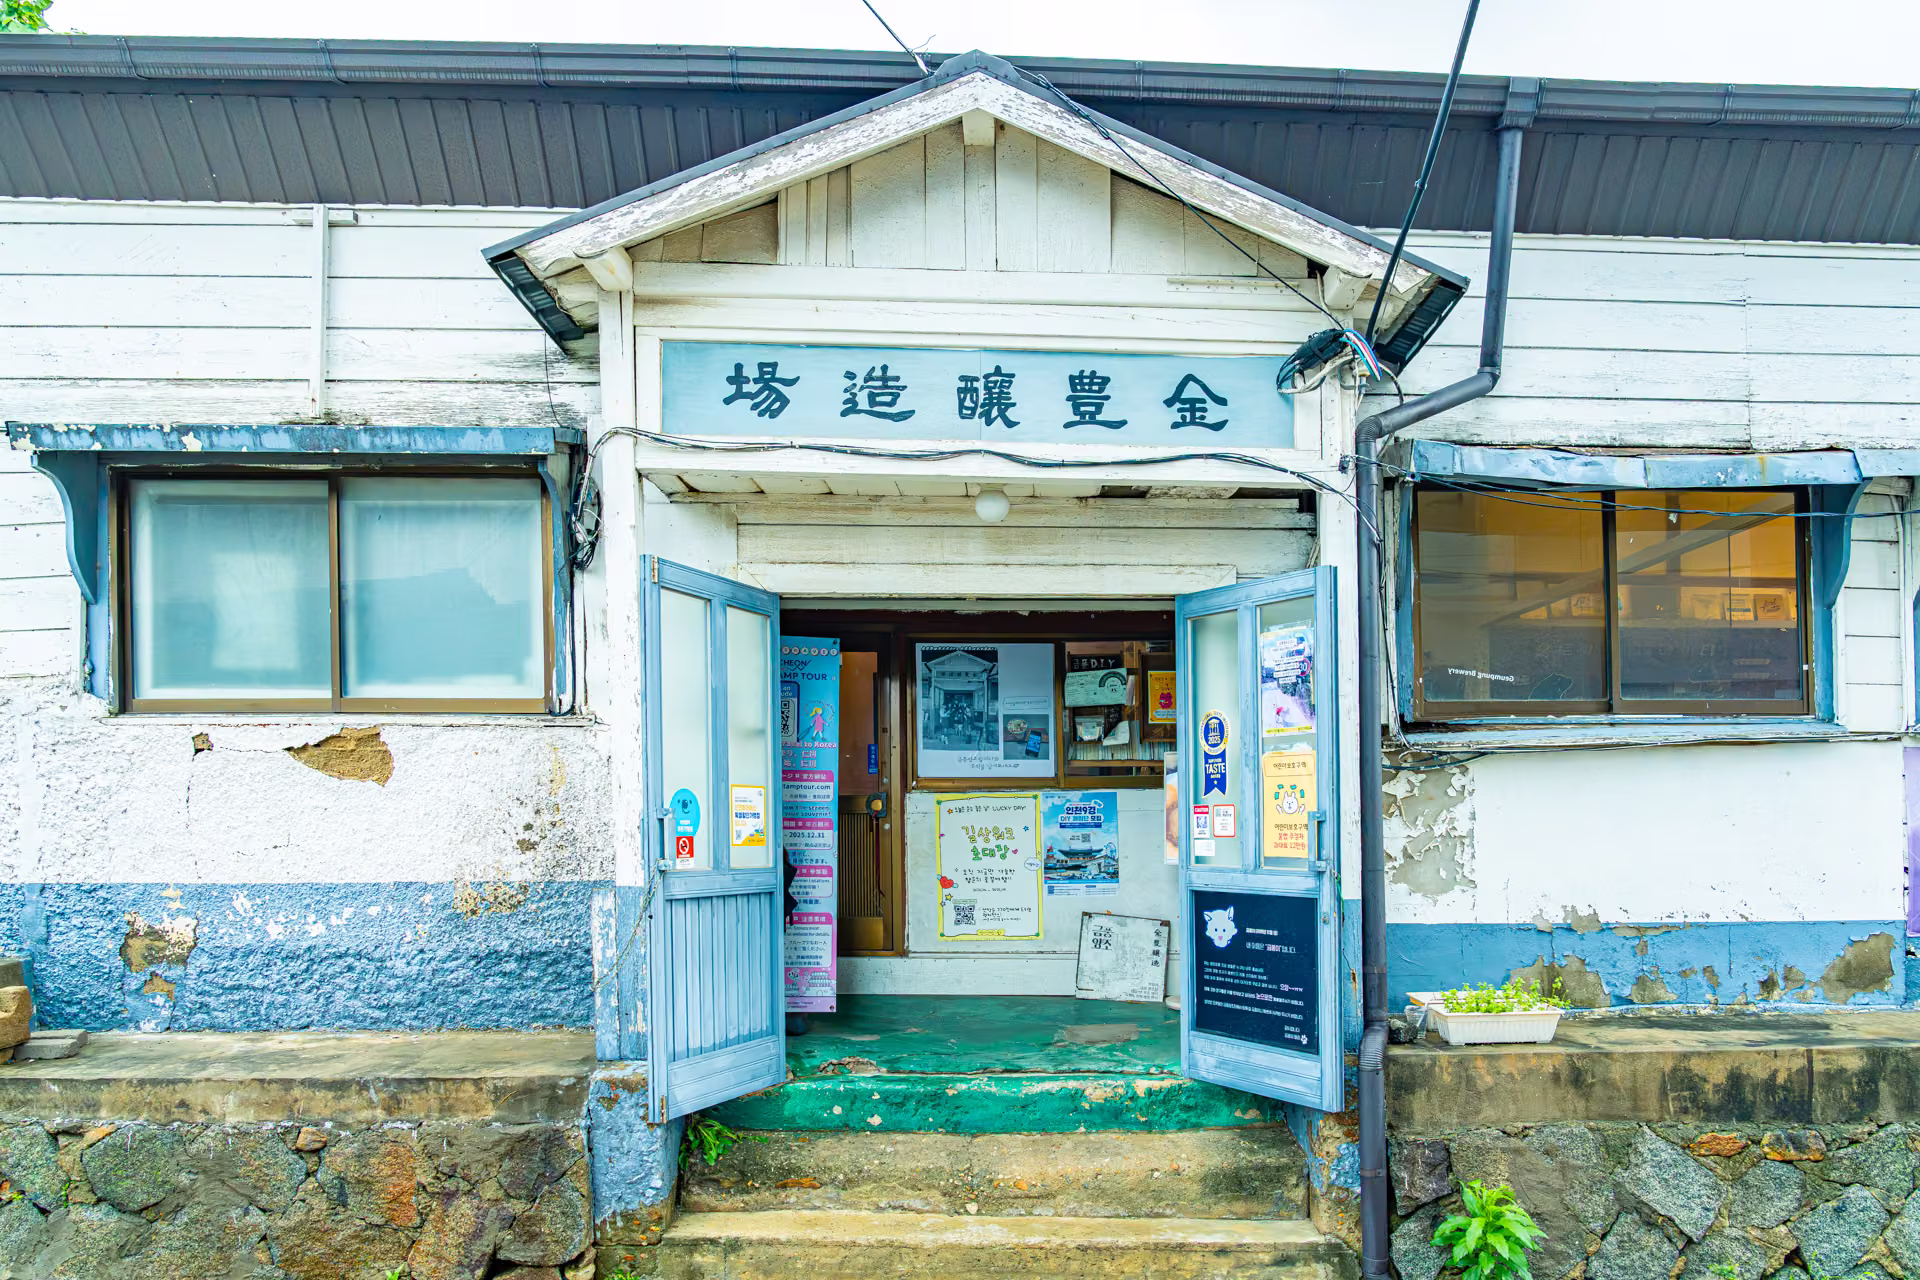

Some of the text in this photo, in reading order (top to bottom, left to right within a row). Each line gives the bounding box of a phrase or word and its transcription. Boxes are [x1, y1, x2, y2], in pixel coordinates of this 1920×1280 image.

[801, 673, 828, 681] TOUR
[1205, 763, 1226, 774] TASTE
[1273, 762, 1307, 771] 어린이보호구역
[992, 804, 1012, 812] LUCKY
[1066, 806, 1097, 815] 인천9경
[1274, 823, 1308, 831] 어린이보호구역
[971, 845, 1009, 861] 초대장
